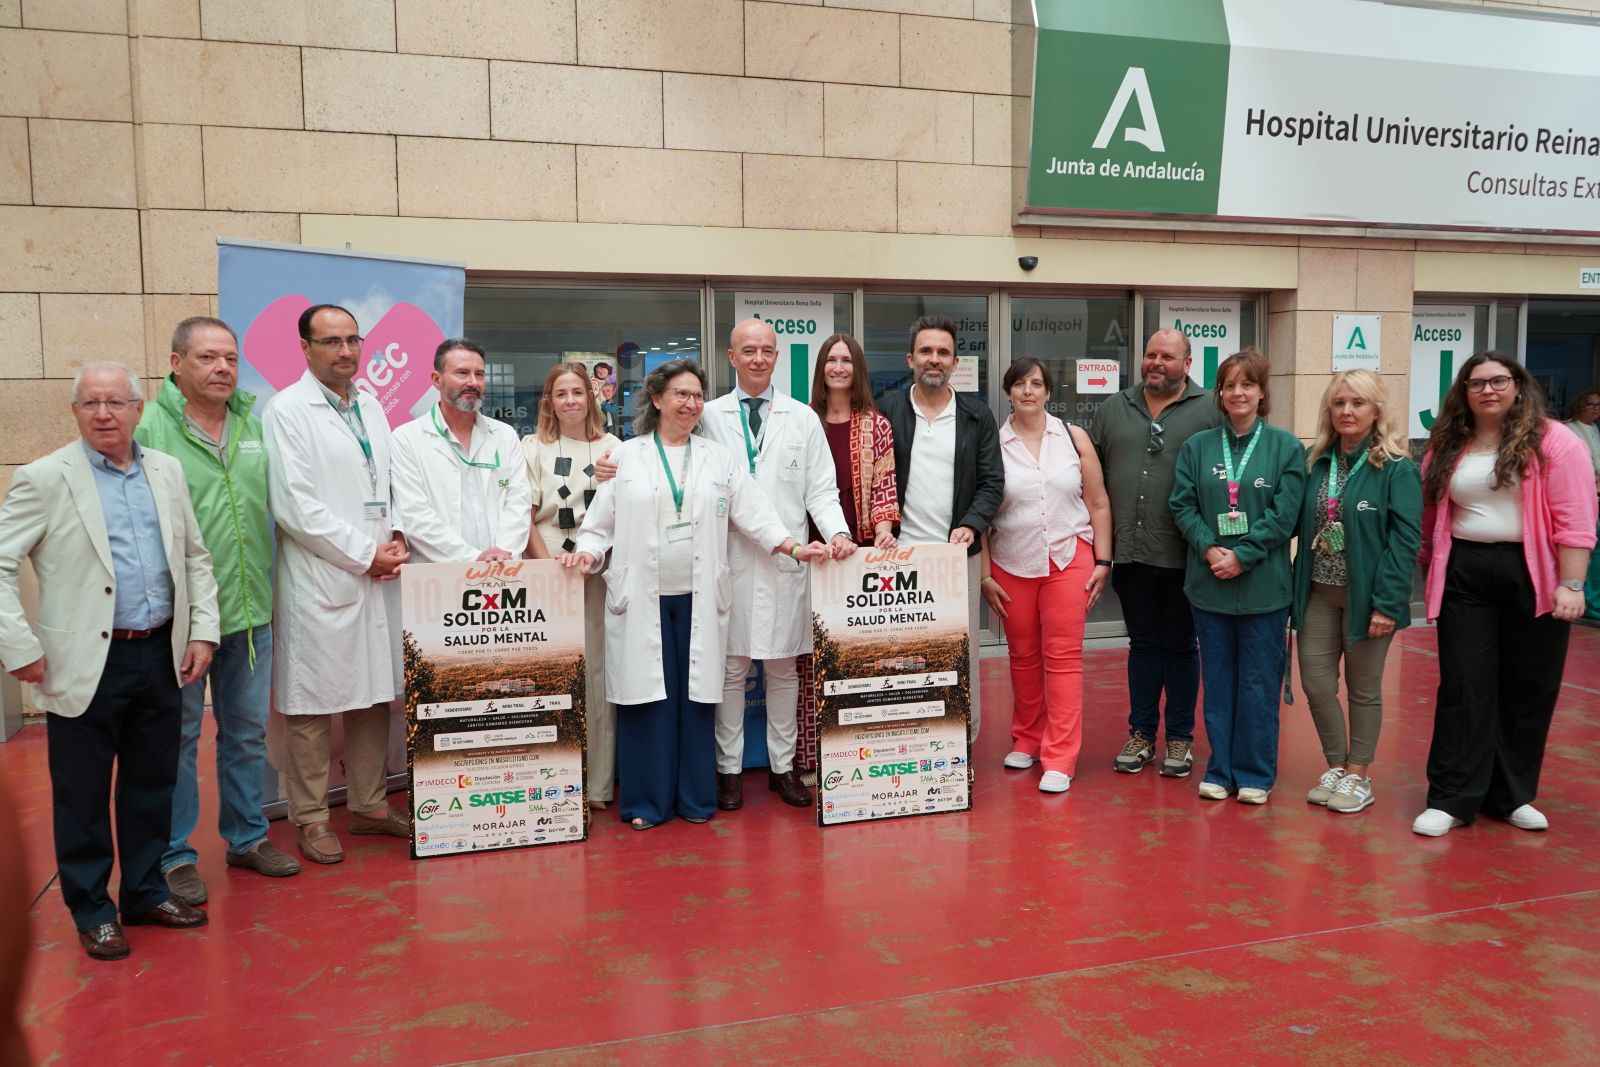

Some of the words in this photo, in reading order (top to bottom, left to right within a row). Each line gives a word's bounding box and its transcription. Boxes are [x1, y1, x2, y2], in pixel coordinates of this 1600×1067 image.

[1246, 108, 1359, 146] Hospital
[1366, 116, 1529, 152] Universitario
[1535, 127, 1600, 157] Reina
[1046, 157, 1096, 176] Junta
[1100, 159, 1121, 177] de
[1123, 161, 1206, 181] Andalucía
[1467, 170, 1568, 198] Consultas
[1174, 319, 1227, 338] Acceso
[1414, 324, 1462, 342] Acceso
[1078, 363, 1119, 373] ENTRADA
[862, 570, 918, 593] CxM
[462, 587, 527, 611] CxM
[846, 591, 935, 608] SOLIDARIA
[443, 609, 546, 628] SOLIDARIA
[847, 615, 886, 627] SALUD
[890, 611, 937, 624] MENTAL
[444, 634, 490, 647] SALUD
[494, 631, 548, 644] MENTAL
[868, 761, 919, 778] SATSE
[469, 789, 527, 807] SATSE
[872, 789, 918, 800] MORAJAR
[421, 805, 440, 814] CSIF
[473, 820, 526, 831] MORAJAR
